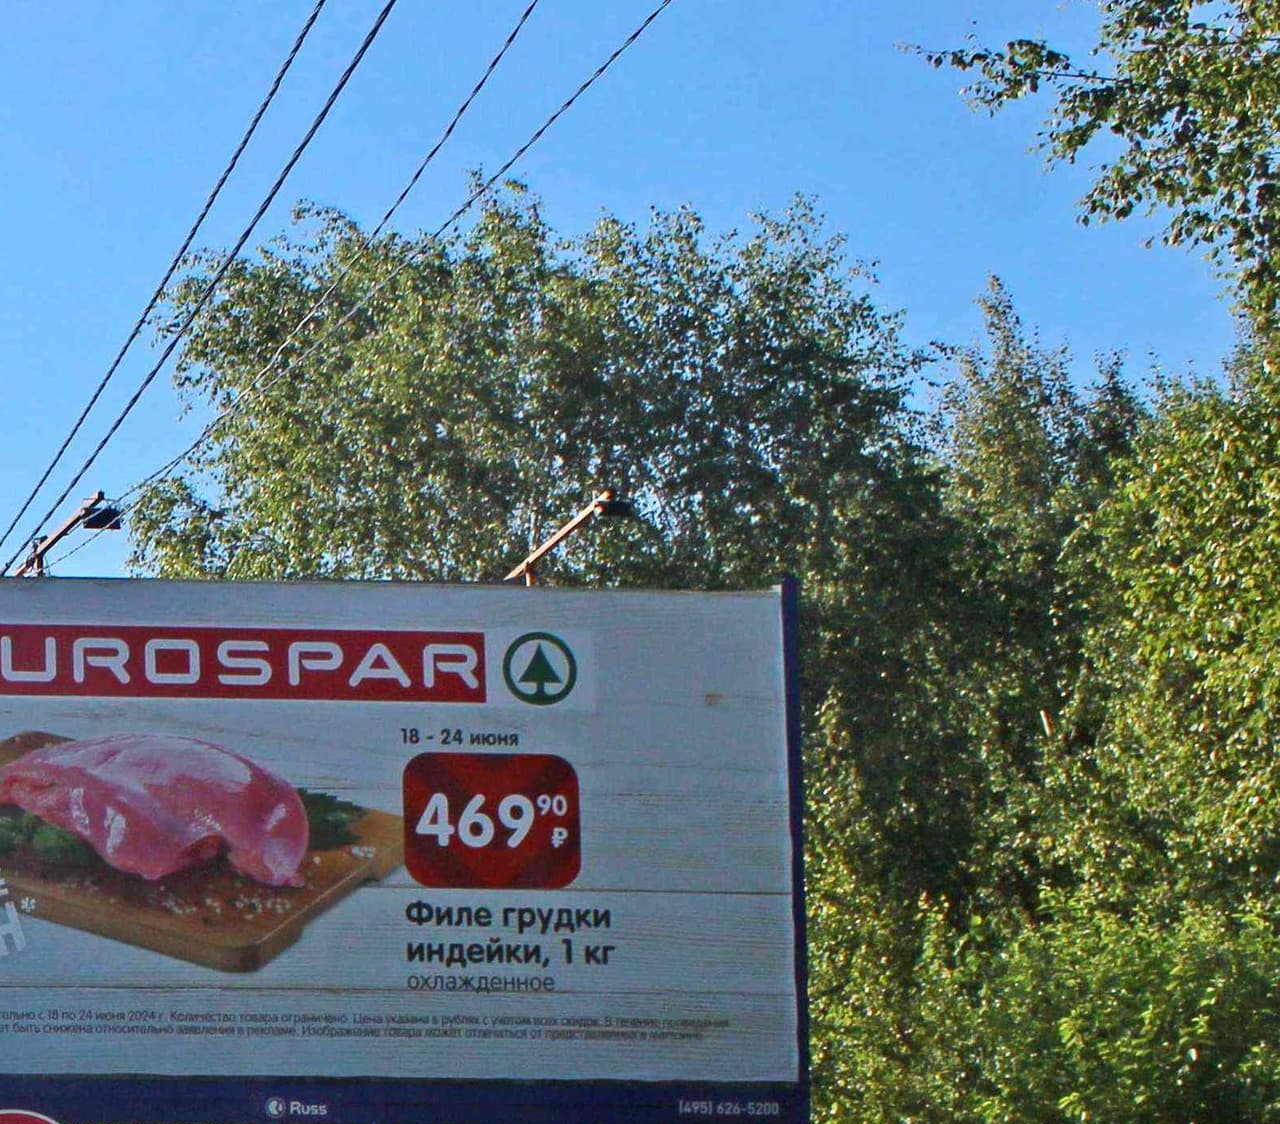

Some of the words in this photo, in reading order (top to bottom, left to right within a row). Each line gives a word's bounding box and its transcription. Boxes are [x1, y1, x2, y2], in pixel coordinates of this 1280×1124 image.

[400, 728, 420, 745] 18
[440, 729, 463, 746] 24
[469, 732, 520, 747] июня
[415, 793, 535, 849] 469
[536, 794, 568, 817] 90
[404, 900, 493, 928] Филе
[502, 906, 611, 935] грудки
[406, 937, 551, 968] индейки,
[560, 938, 573, 964] 1
[584, 944, 616, 965] кг
[406, 973, 556, 994] охлажденное
[48, 1009, 59, 1023] 18
[61, 1009, 76, 1023] по
[78, 1009, 92, 1023] 24
[95, 1009, 126, 1023] июня
[128, 1009, 157, 1023] 2024
[170, 1010, 236, 1024] Количество
[239, 1010, 280, 1024] товара
[353, 1011, 384, 1025] Цена
[12, 1022, 41, 1035] быть
[95, 1023, 174, 1036] относительно
[289, 1100, 328, 1116] Russ
[716, 1101, 780, 1116] 626-5200
